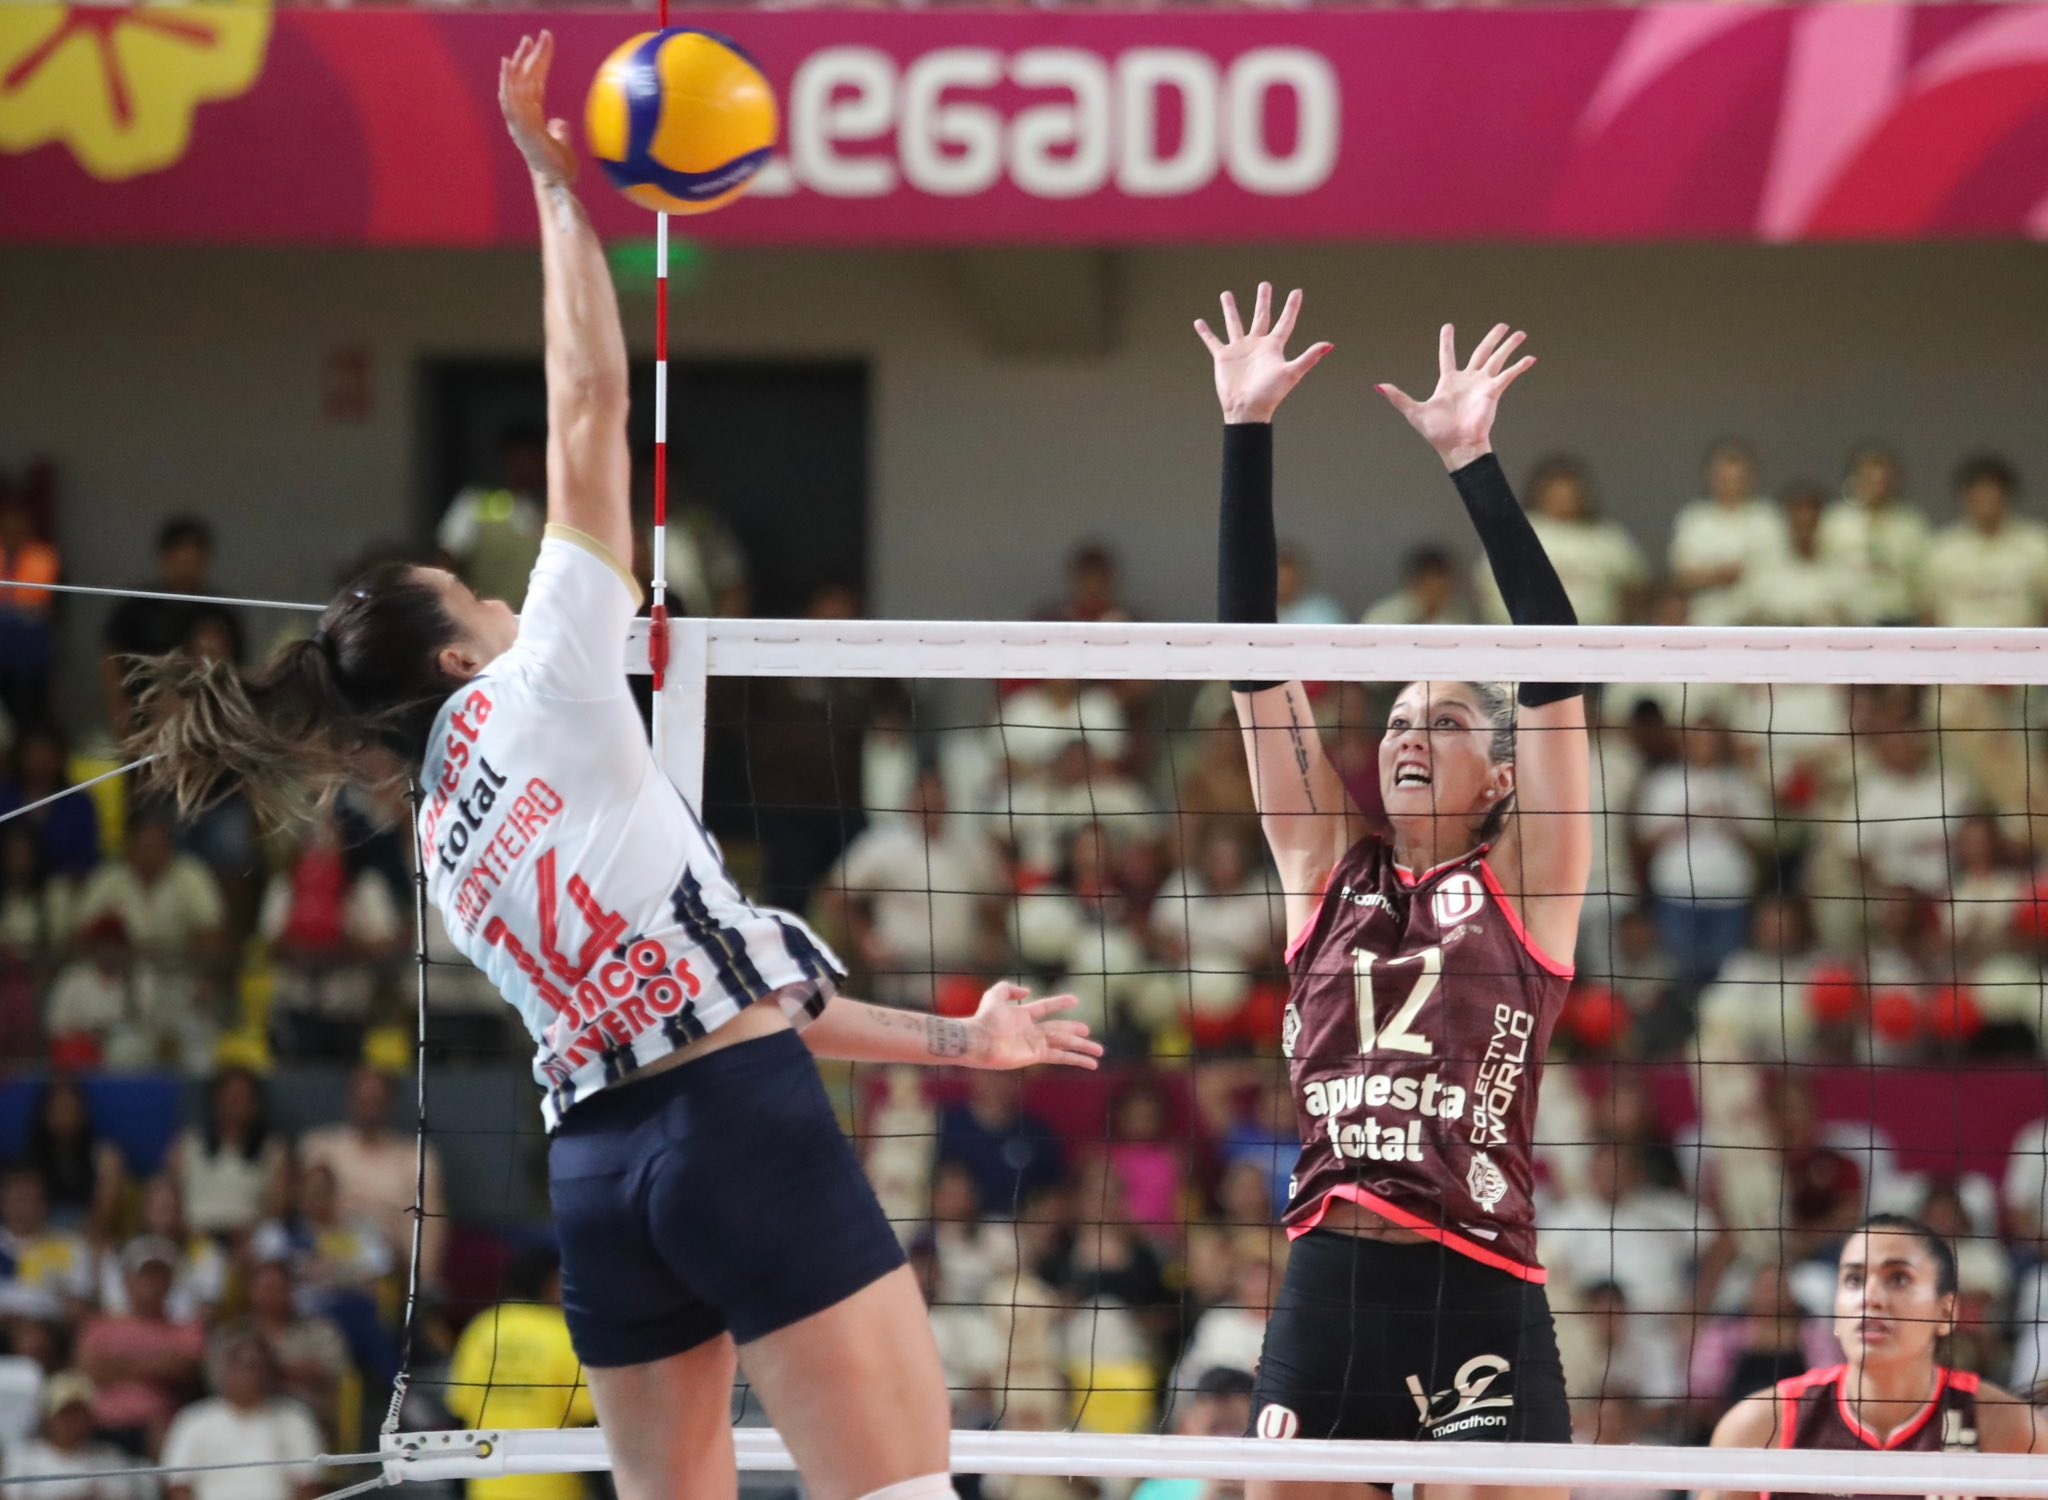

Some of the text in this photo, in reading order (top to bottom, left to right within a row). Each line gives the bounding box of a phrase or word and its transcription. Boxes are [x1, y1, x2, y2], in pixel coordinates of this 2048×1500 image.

[745, 46, 1340, 198] eGaDO
[438, 756, 507, 875] total
[455, 777, 564, 936] MONTEIRO
[484, 847, 628, 1012] 14
[541, 957, 702, 1088] IVEROS
[1351, 947, 1444, 1055] 12
[1303, 1073, 1466, 1120] apuesta
[1327, 1116, 1424, 1162] total
[1469, 1003, 1511, 1144] COLECTIVO
[1486, 1010, 1535, 1148] WORLD
[1431, 1415, 1507, 1438] marathon
